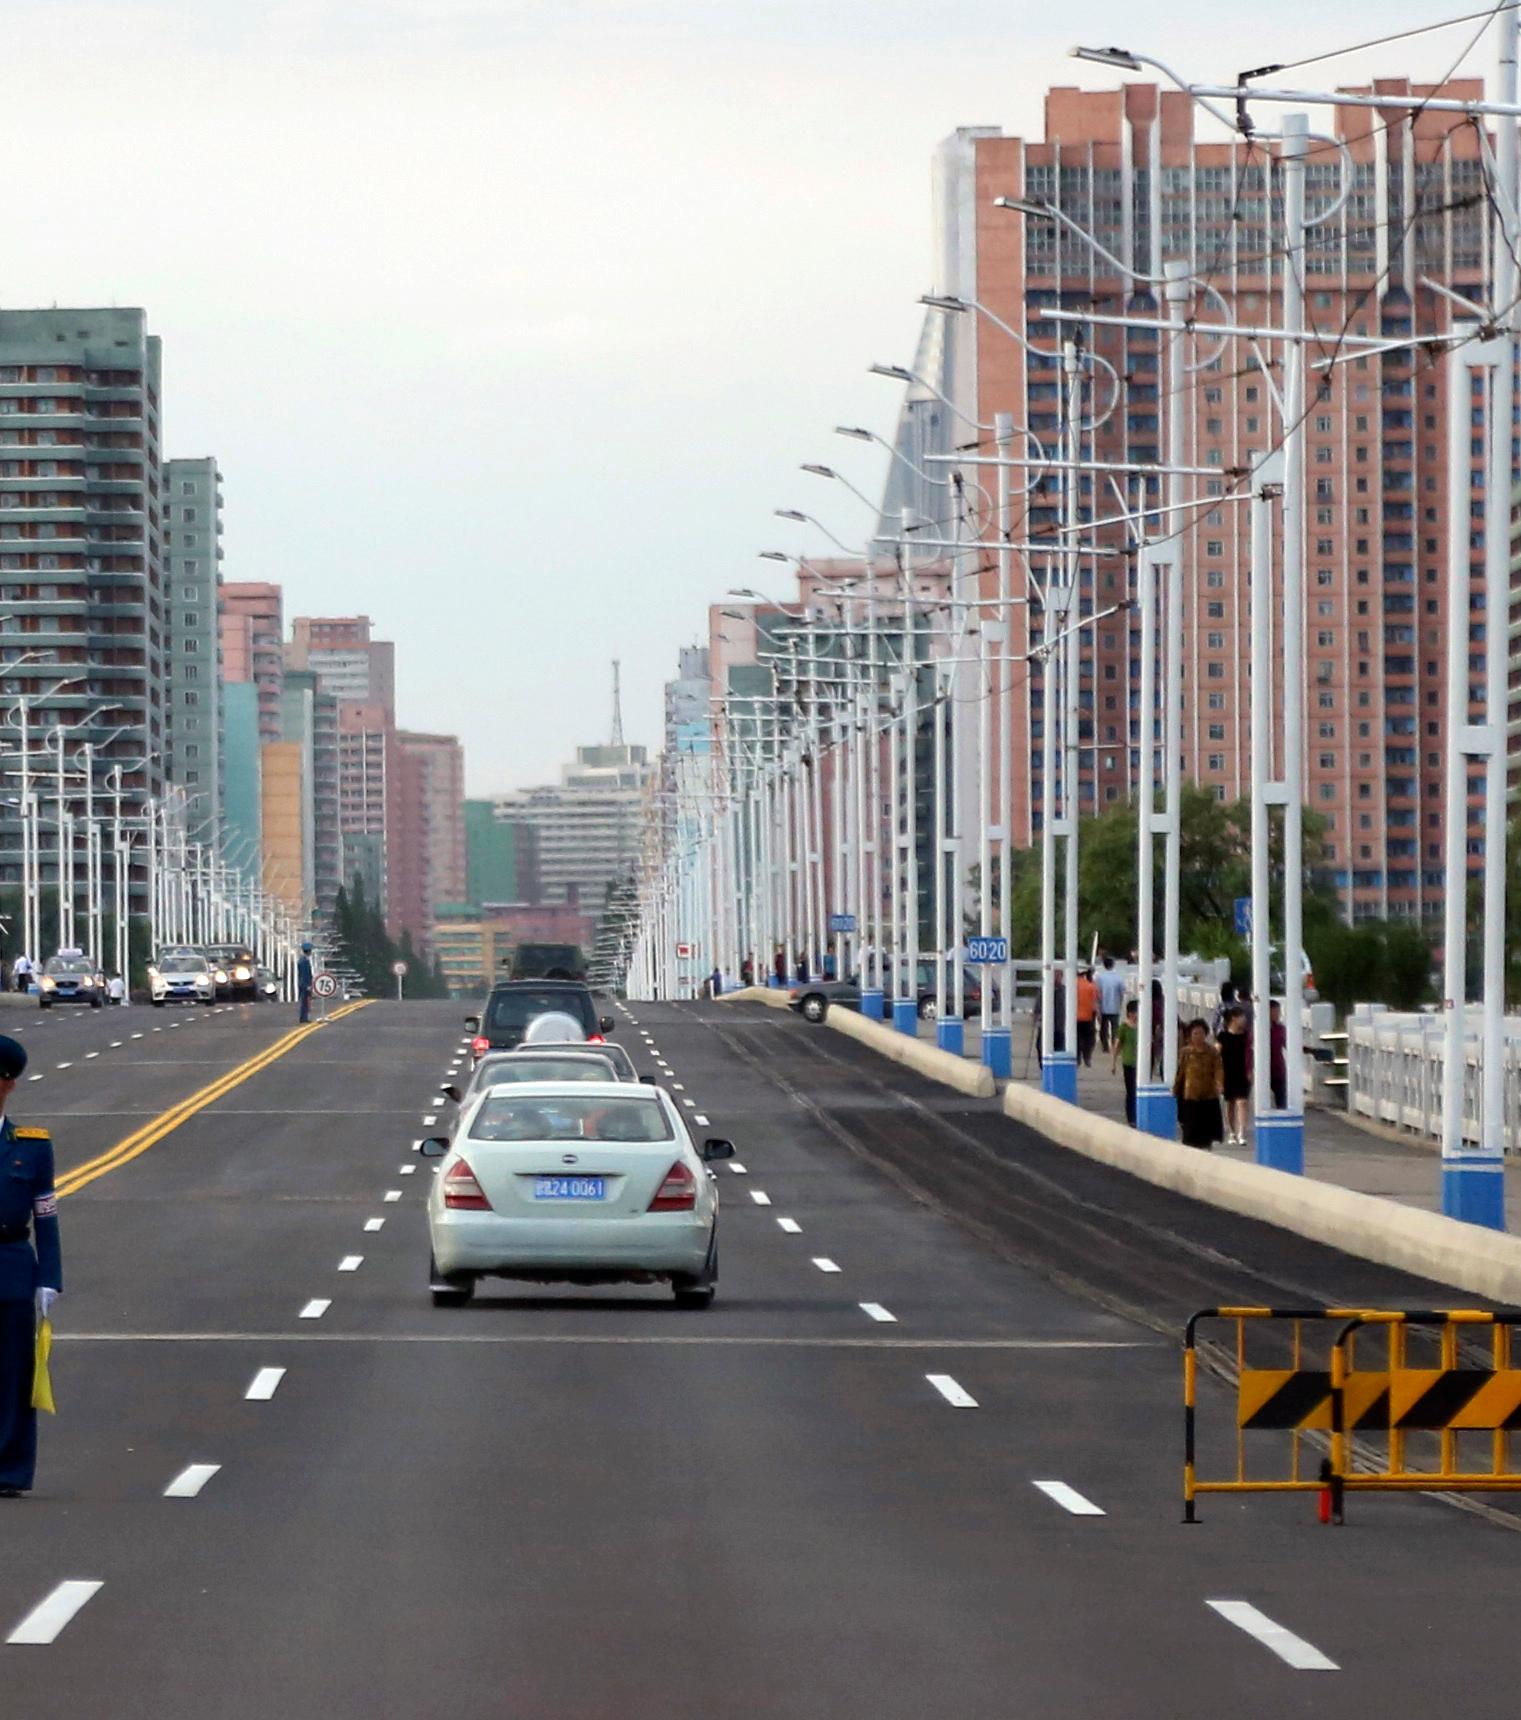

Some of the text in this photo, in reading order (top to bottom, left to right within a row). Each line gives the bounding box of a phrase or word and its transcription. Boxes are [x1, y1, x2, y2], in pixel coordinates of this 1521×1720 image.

[970, 940, 1006, 960] 6020
[319, 979, 332, 993] 15
[571, 1180, 603, 1196] 0061
